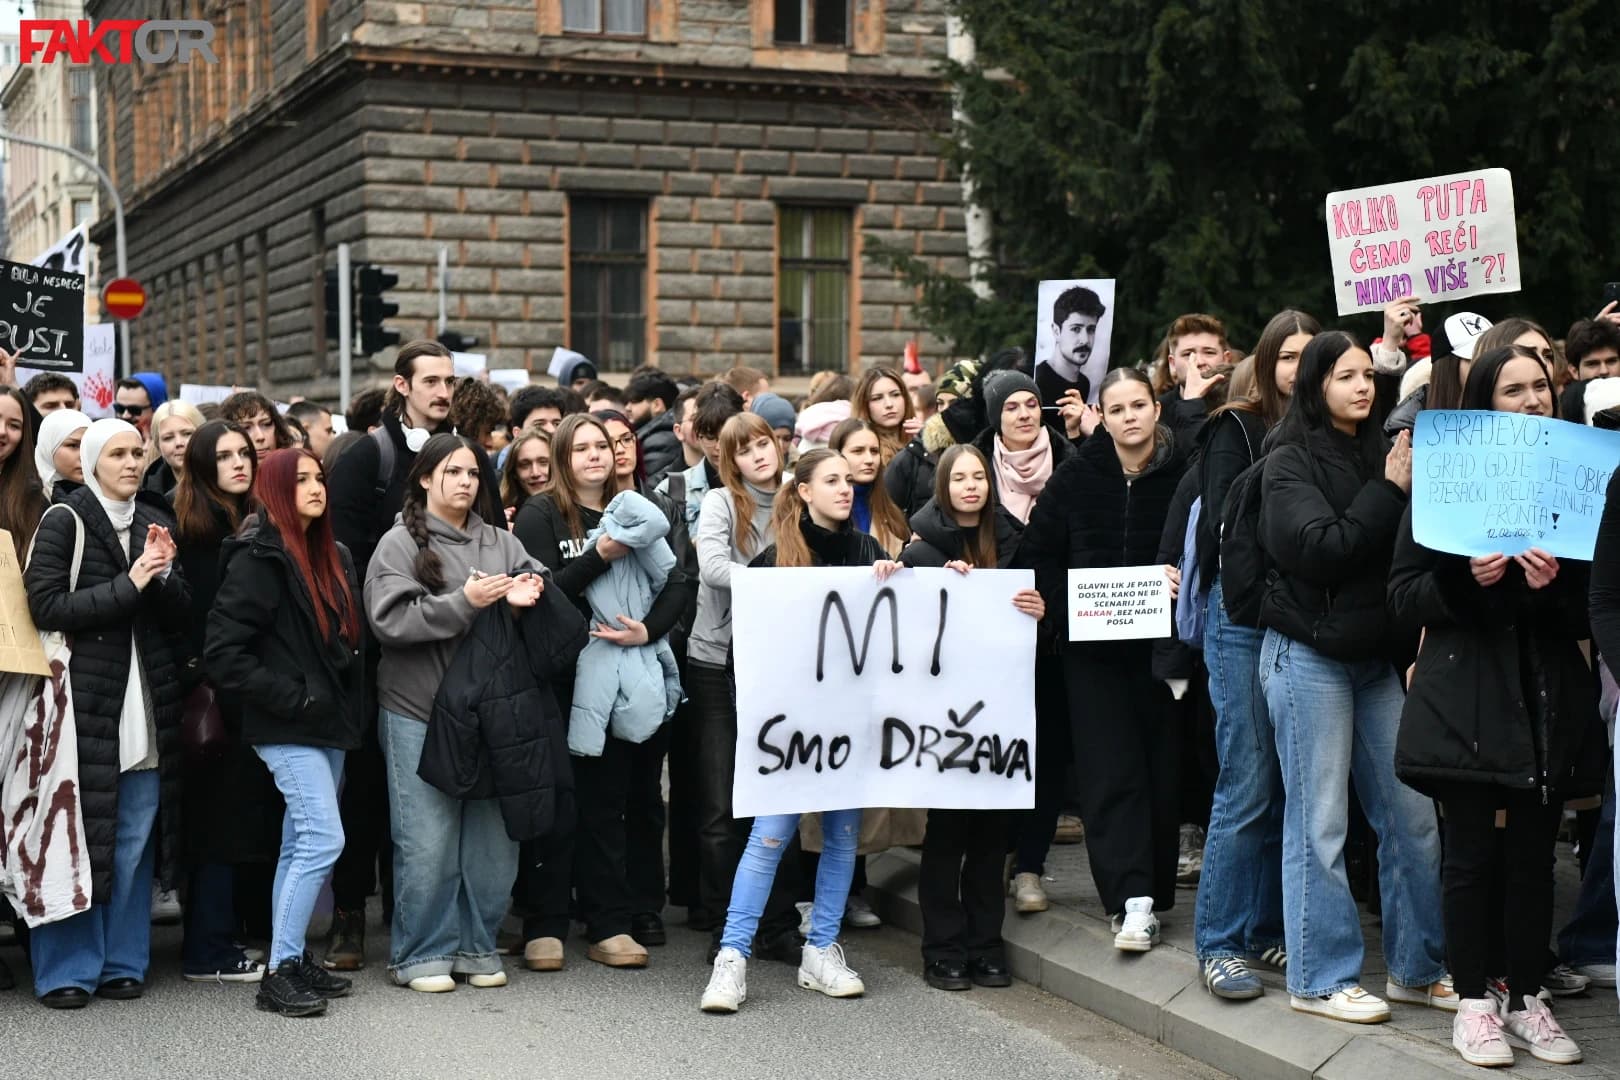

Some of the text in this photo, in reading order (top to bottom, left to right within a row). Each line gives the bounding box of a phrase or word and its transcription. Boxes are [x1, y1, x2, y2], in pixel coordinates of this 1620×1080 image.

[1332, 178, 1487, 239] KOLIKO PUTA
[1350, 221, 1478, 273] ĆEMO REĆI
[12, 291, 53, 318] JE
[1427, 413, 1549, 447] SARAJEVO:
[1426, 451, 1476, 479] GRAD
[1484, 451, 1534, 479] GDJE
[1544, 456, 1569, 487] JE
[1496, 480, 1545, 503] PRELAZ
[1552, 487, 1593, 517] LINIJA
[1094, 600, 1135, 608] SCENARIJ
[816, 586, 948, 682] MI
[757, 700, 1033, 782] SMO DRŽAVA
